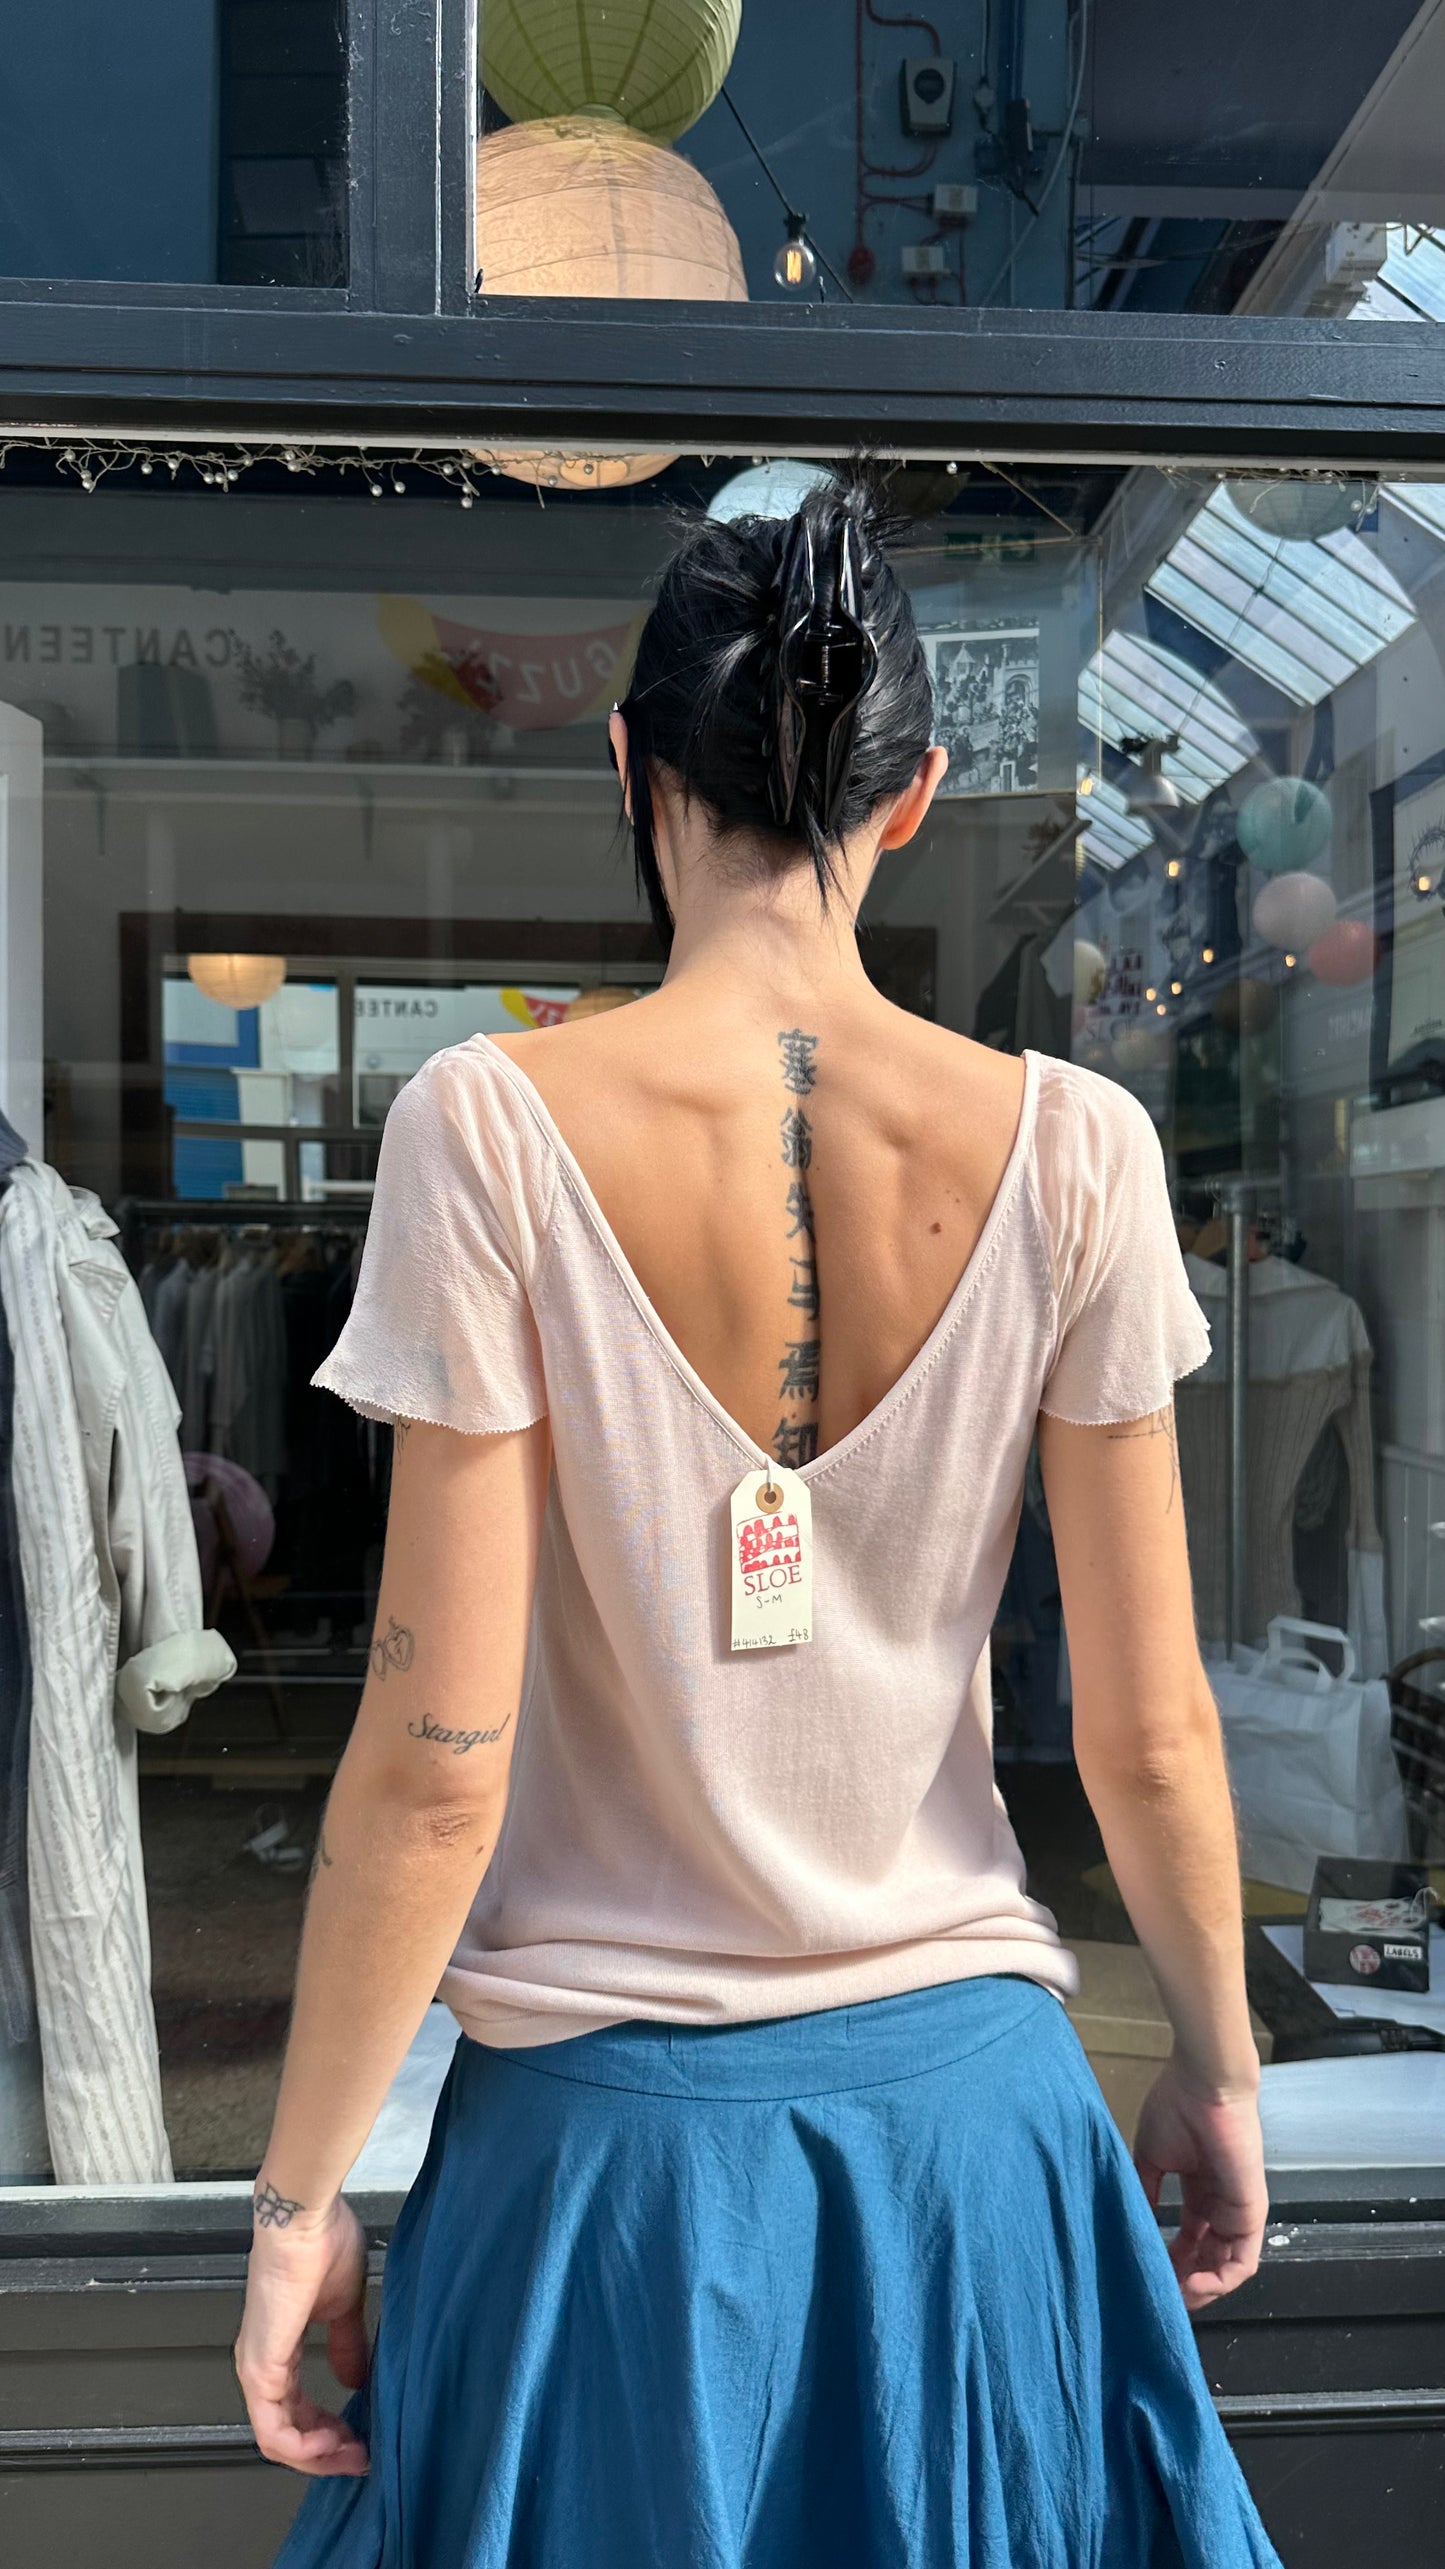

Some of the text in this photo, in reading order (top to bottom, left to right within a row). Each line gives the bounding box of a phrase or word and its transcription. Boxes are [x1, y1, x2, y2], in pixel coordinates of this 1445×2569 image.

[743, 1564, 802, 1596] SLOE
[756, 1593, 783, 1609] S-M
[787, 1628, 809, 1642] £48
[1386, 1946, 1419, 1958] LABELS
